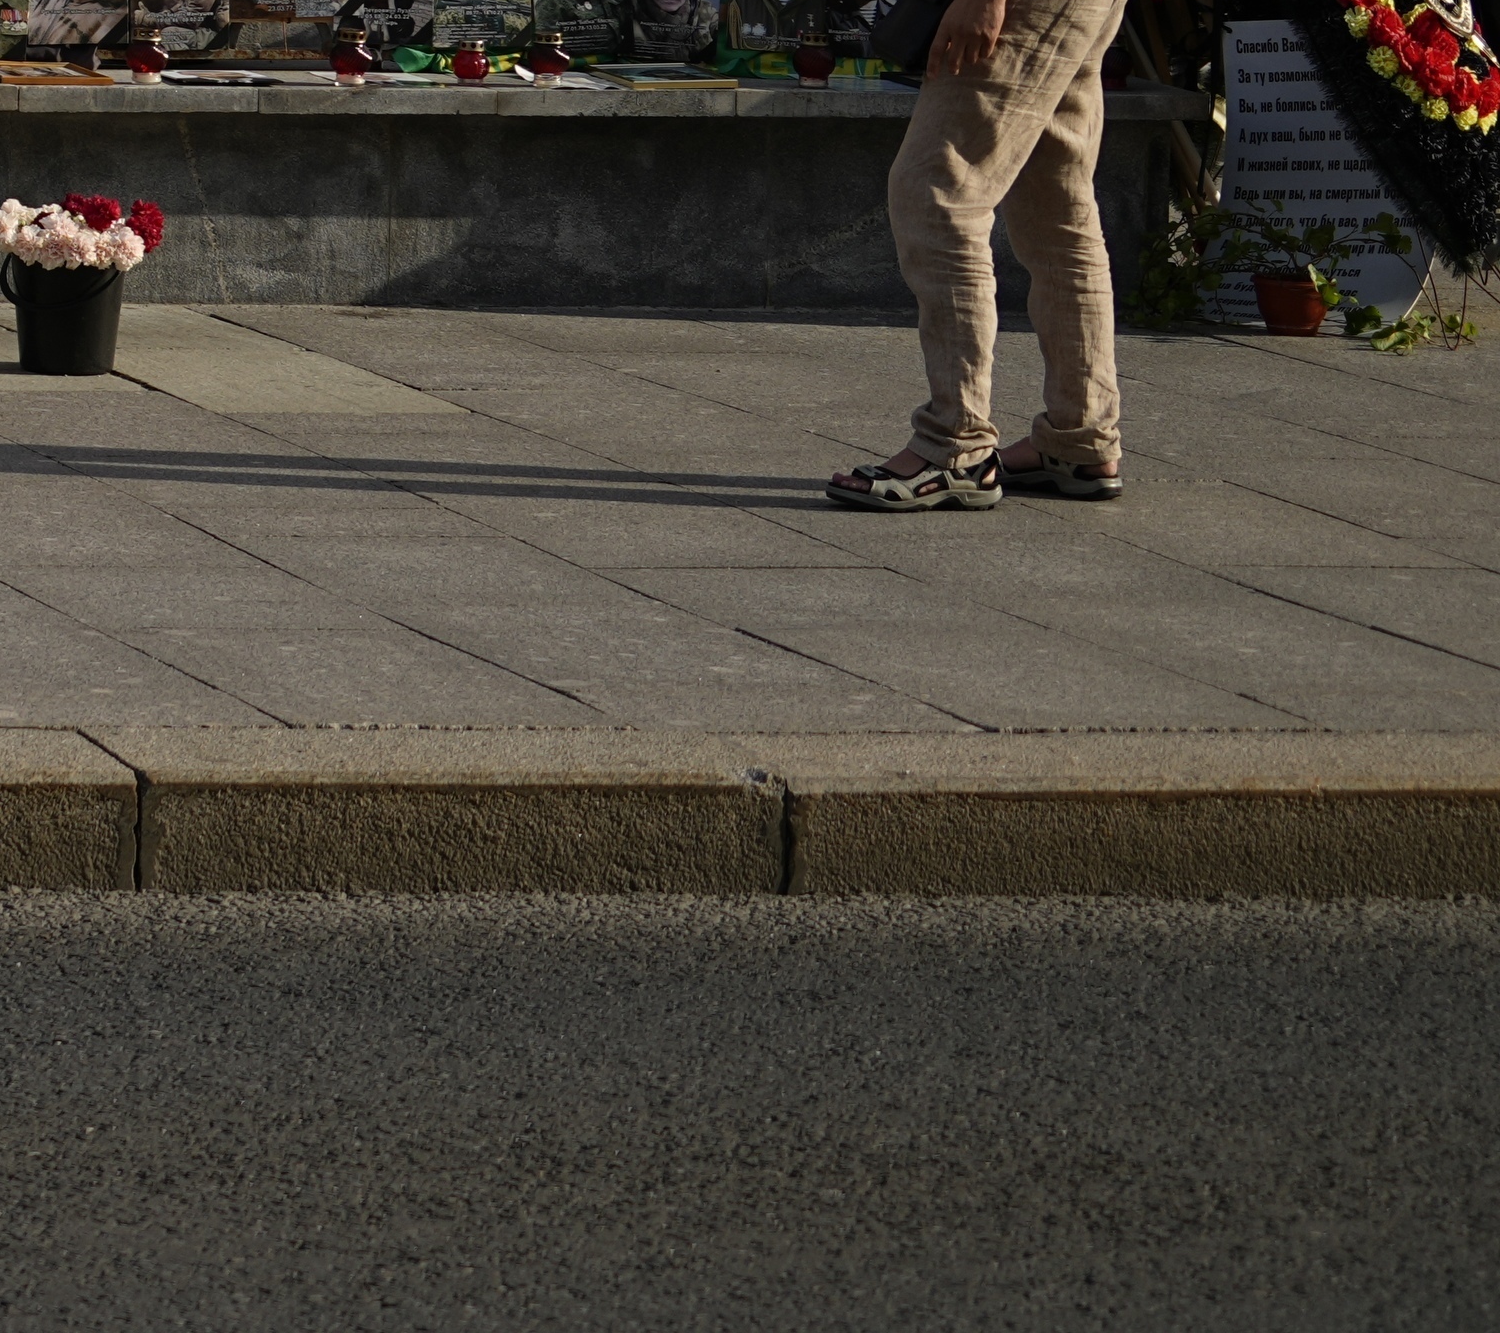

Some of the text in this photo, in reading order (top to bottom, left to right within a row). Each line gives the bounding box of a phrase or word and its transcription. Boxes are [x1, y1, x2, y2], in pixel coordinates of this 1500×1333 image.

[1235, 37, 1280, 56] Спасибо
[1237, 69, 1266, 88] За ту
[1238, 97, 1318, 114] Вы, не боялись
[1238, 127, 1342, 146] А дух ваш, было не
[1236, 156, 1341, 174] И жизней своих, не
[1233, 183, 1382, 203] Ведь шли вы, на смертный
[1268, 215, 1295, 229] того,
[1299, 215, 1318, 228] что
[1319, 213, 1336, 228] бы
[1337, 215, 1359, 230] вас,
